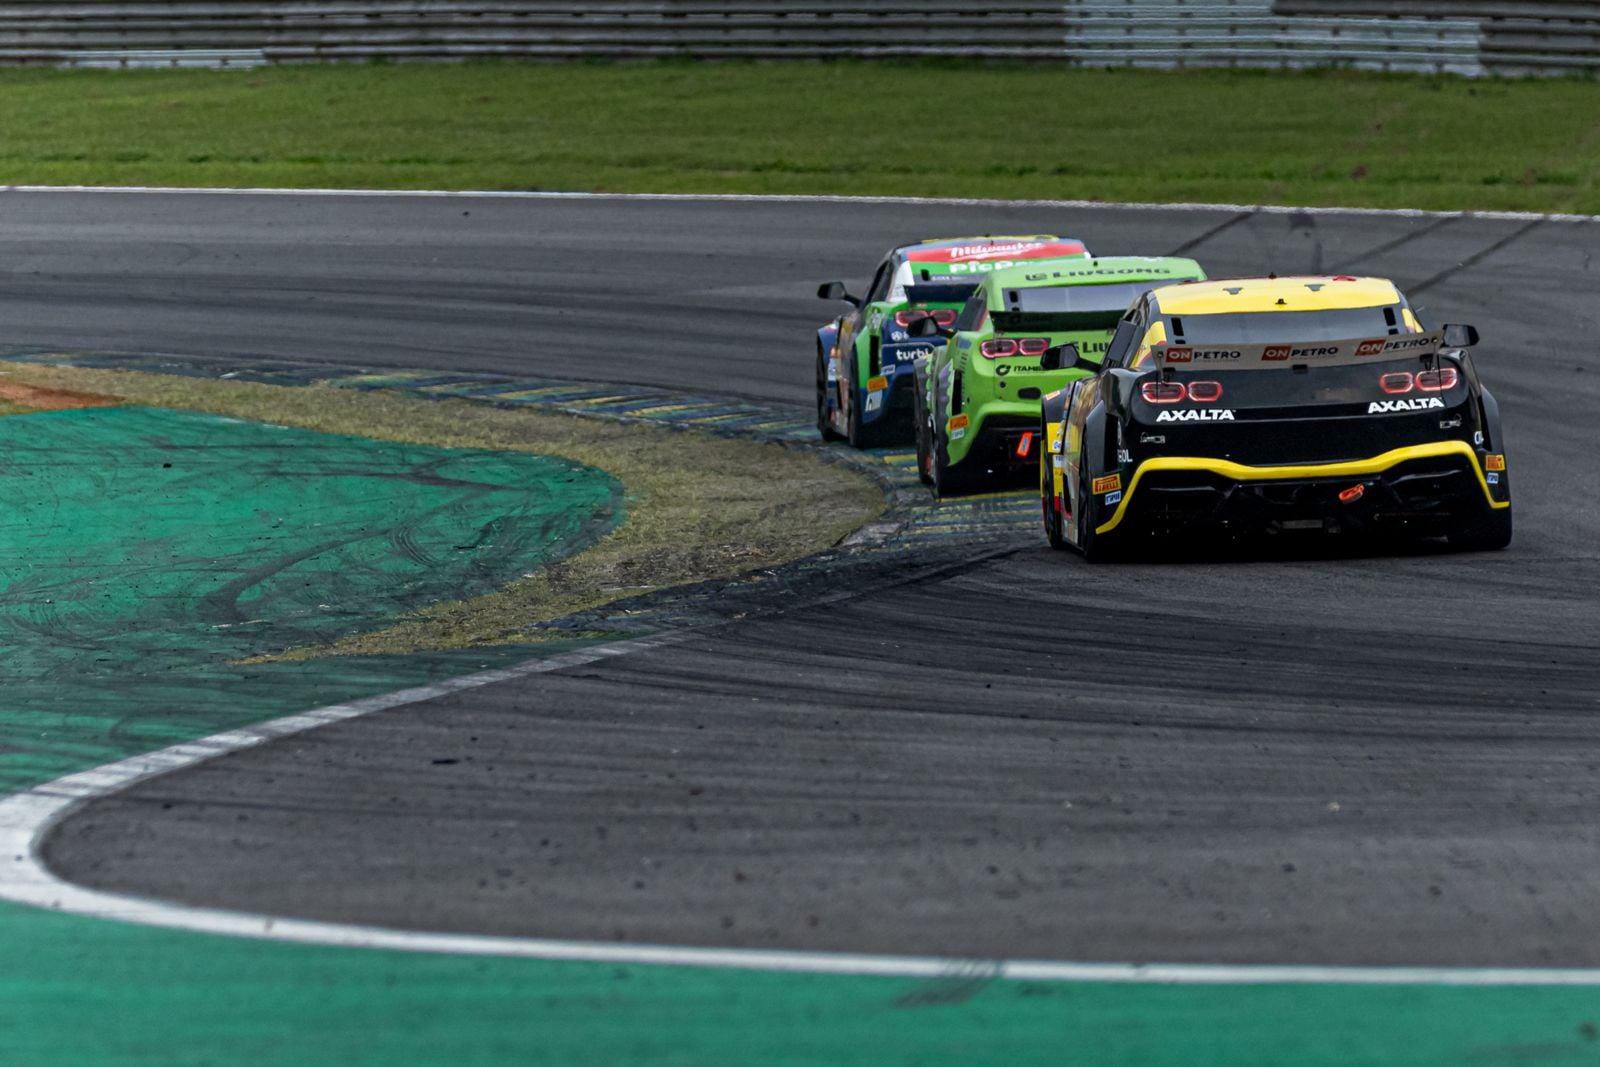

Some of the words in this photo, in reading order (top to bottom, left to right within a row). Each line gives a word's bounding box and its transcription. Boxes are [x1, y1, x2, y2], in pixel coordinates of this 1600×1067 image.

[949, 260, 1030, 273] PicP
[1265, 348, 1288, 358] ON
[1291, 346, 1339, 356] PETRO
[1359, 342, 1383, 354] ON
[1384, 338, 1429, 350] PETRO
[1168, 351, 1191, 360] ON
[1194, 350, 1241, 359] PETRO
[1368, 397, 1445, 413] AXALTA
[1156, 409, 1236, 422] AXALTA
